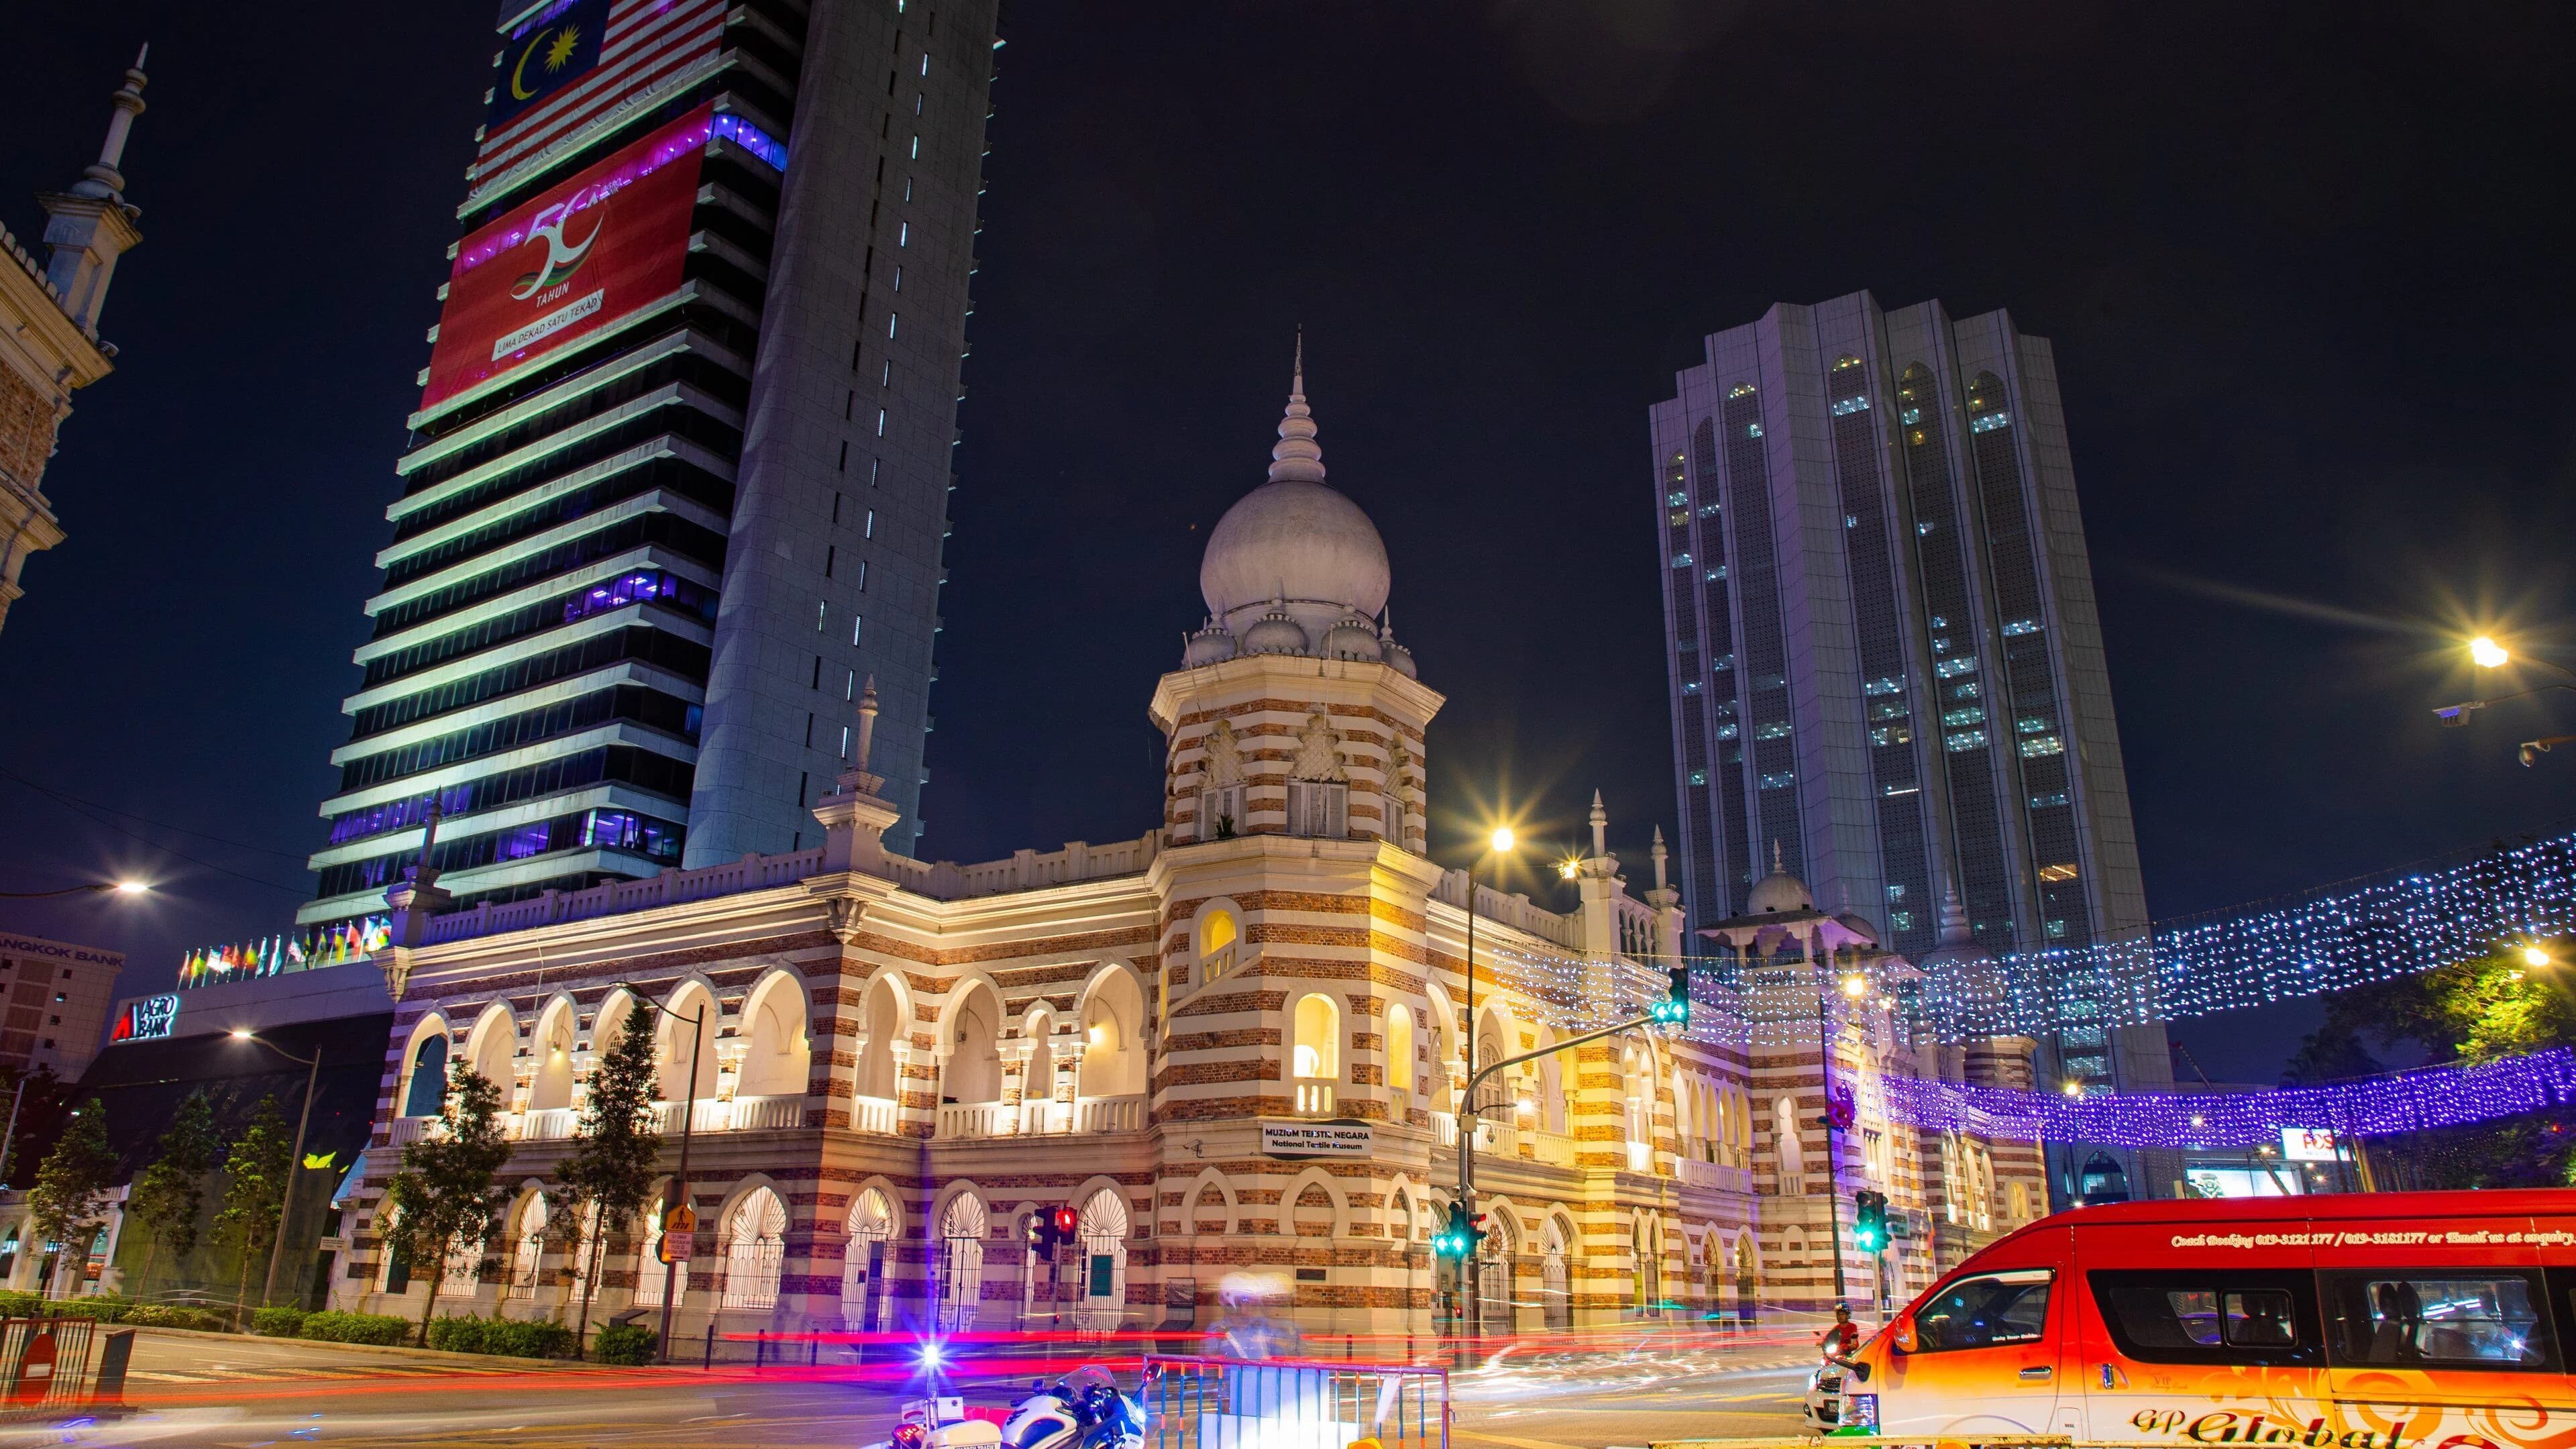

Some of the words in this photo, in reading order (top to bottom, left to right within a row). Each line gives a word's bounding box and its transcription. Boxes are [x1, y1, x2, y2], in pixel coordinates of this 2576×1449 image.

[537, 282, 570, 308] TAHUN
[498, 337, 516, 354] LIMA
[518, 324, 545, 343] DEKAD
[547, 312, 568, 330] SATU
[570, 299, 597, 318] TEKAD
[74, 951, 124, 967] BANK
[141, 997, 174, 1018] AGRO
[139, 1017, 171, 1037] BANK
[1265, 1129, 1299, 1137] MUZIUM
[1334, 1131, 1369, 1140] NEGARA
[1272, 1140, 1305, 1148] National
[2171, 1234, 2206, 1248] Coach
[2206, 1233, 2254, 1248] Booking
[2428, 1233, 2444, 1243] or
[2446, 1230, 2489, 1244] Email
[2487, 1234, 2505, 1243] us
[2506, 1232, 2523, 1243] at
[2129, 1409, 2186, 1434] GP
[2179, 1412, 2412, 1449] Global
